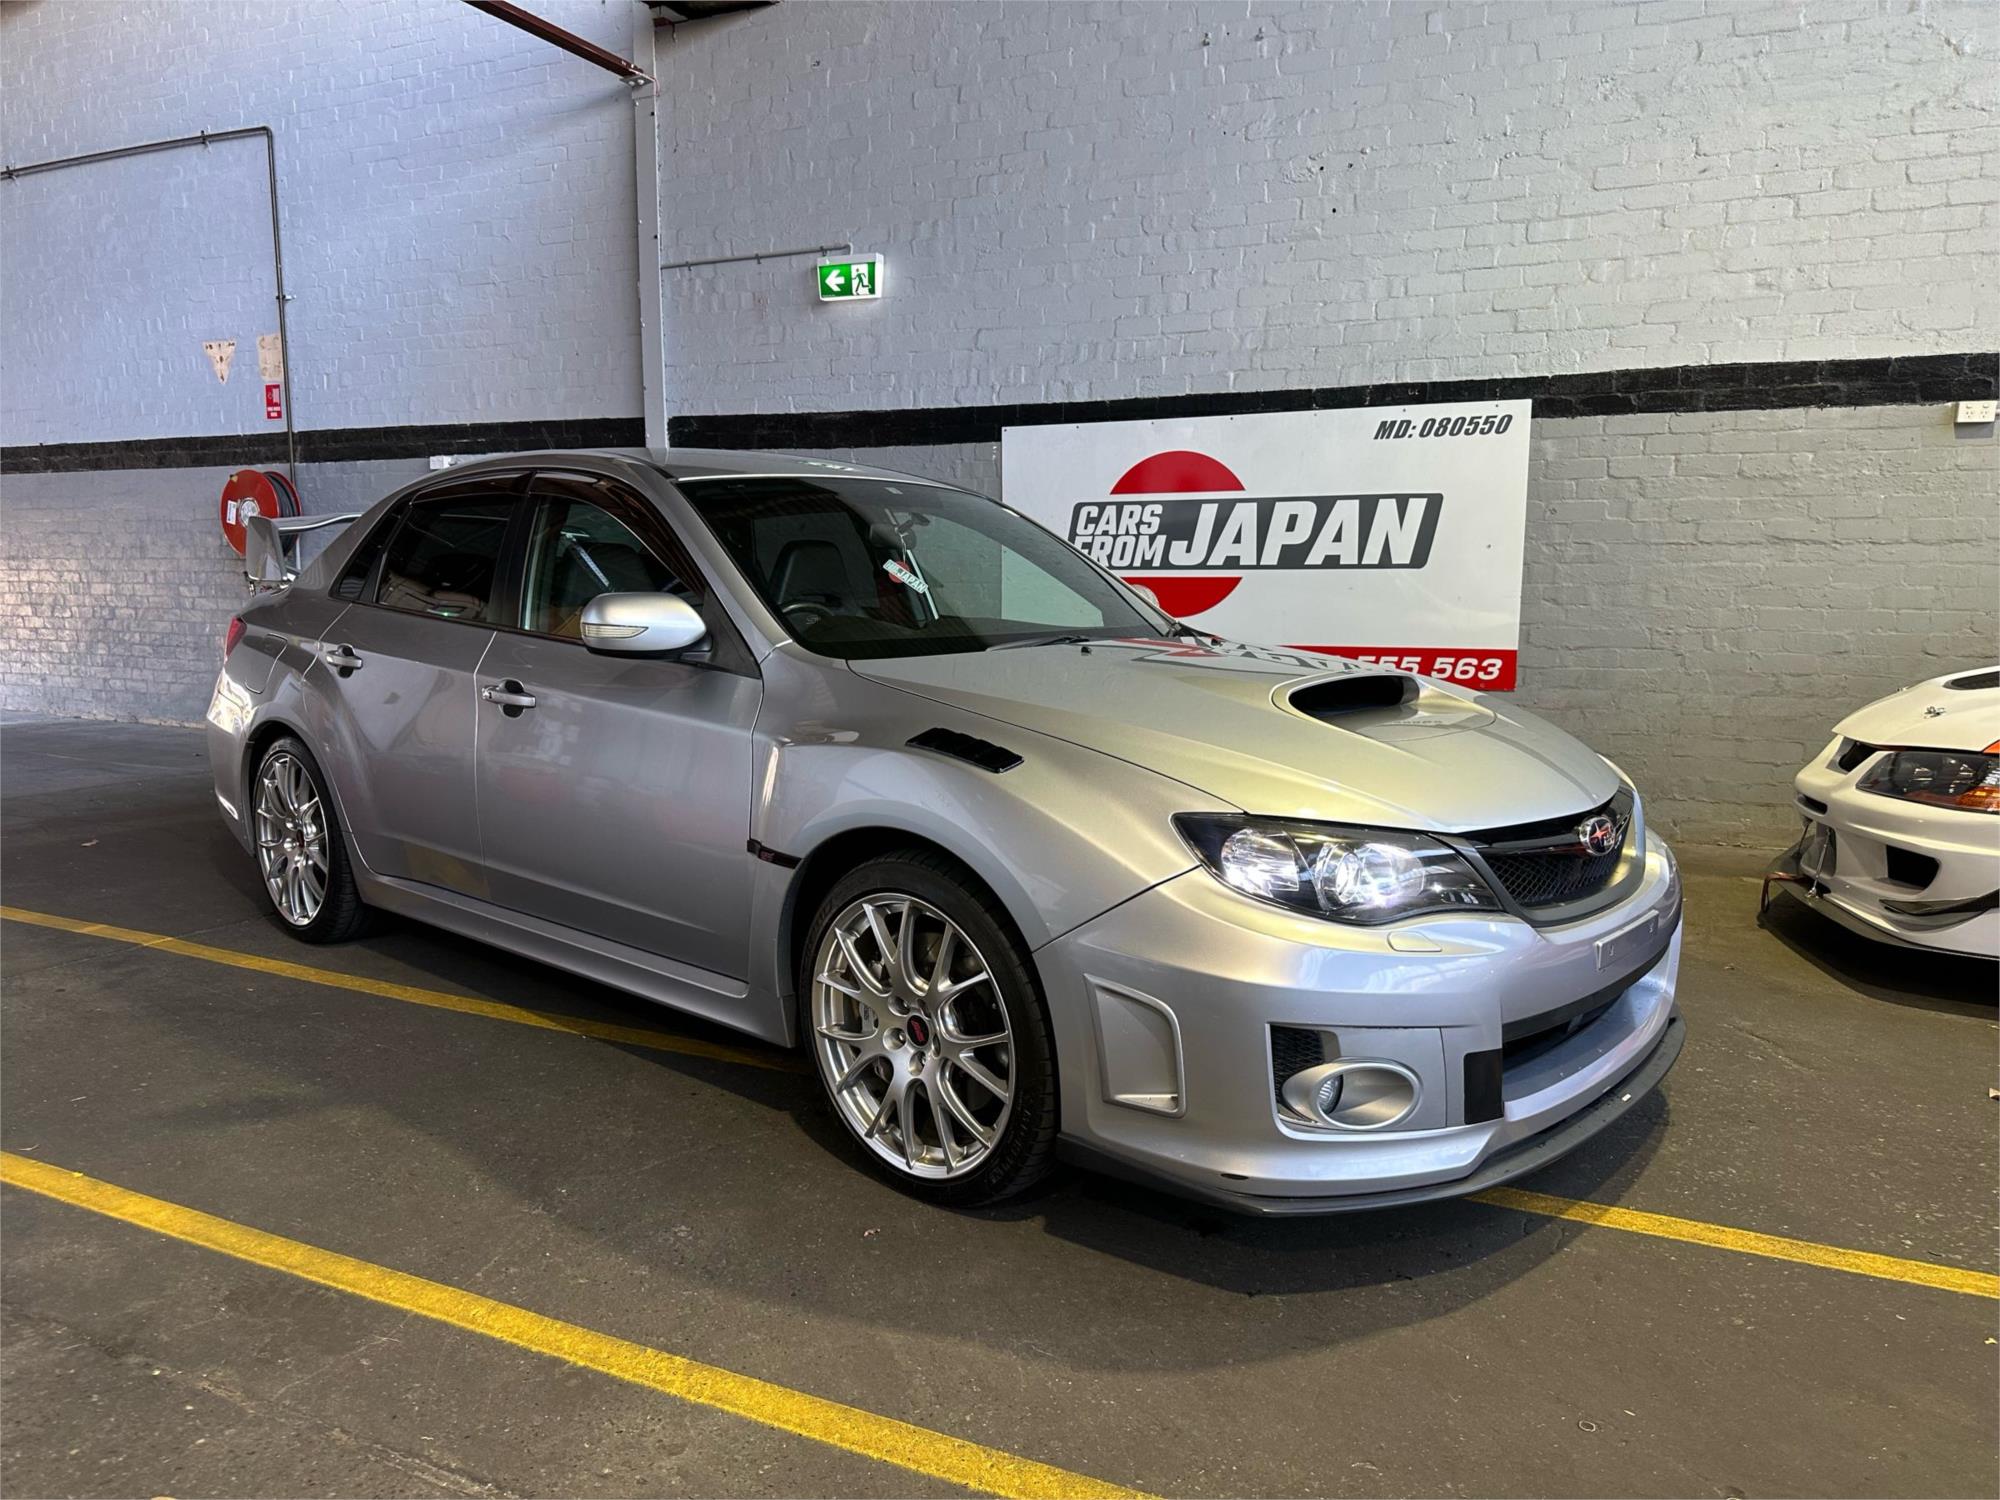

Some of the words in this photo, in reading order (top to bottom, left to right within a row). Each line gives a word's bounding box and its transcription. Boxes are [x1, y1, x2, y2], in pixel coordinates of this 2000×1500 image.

[1373, 420, 1417, 440] MD:
[1418, 414, 1513, 438] 080550
[1076, 504, 1163, 535] CARS
[1168, 499, 1427, 566] JAPAN
[1074, 534, 1167, 567] FROM
[1357, 655, 1422, 674] 55
[1431, 657, 1503, 680] 563
